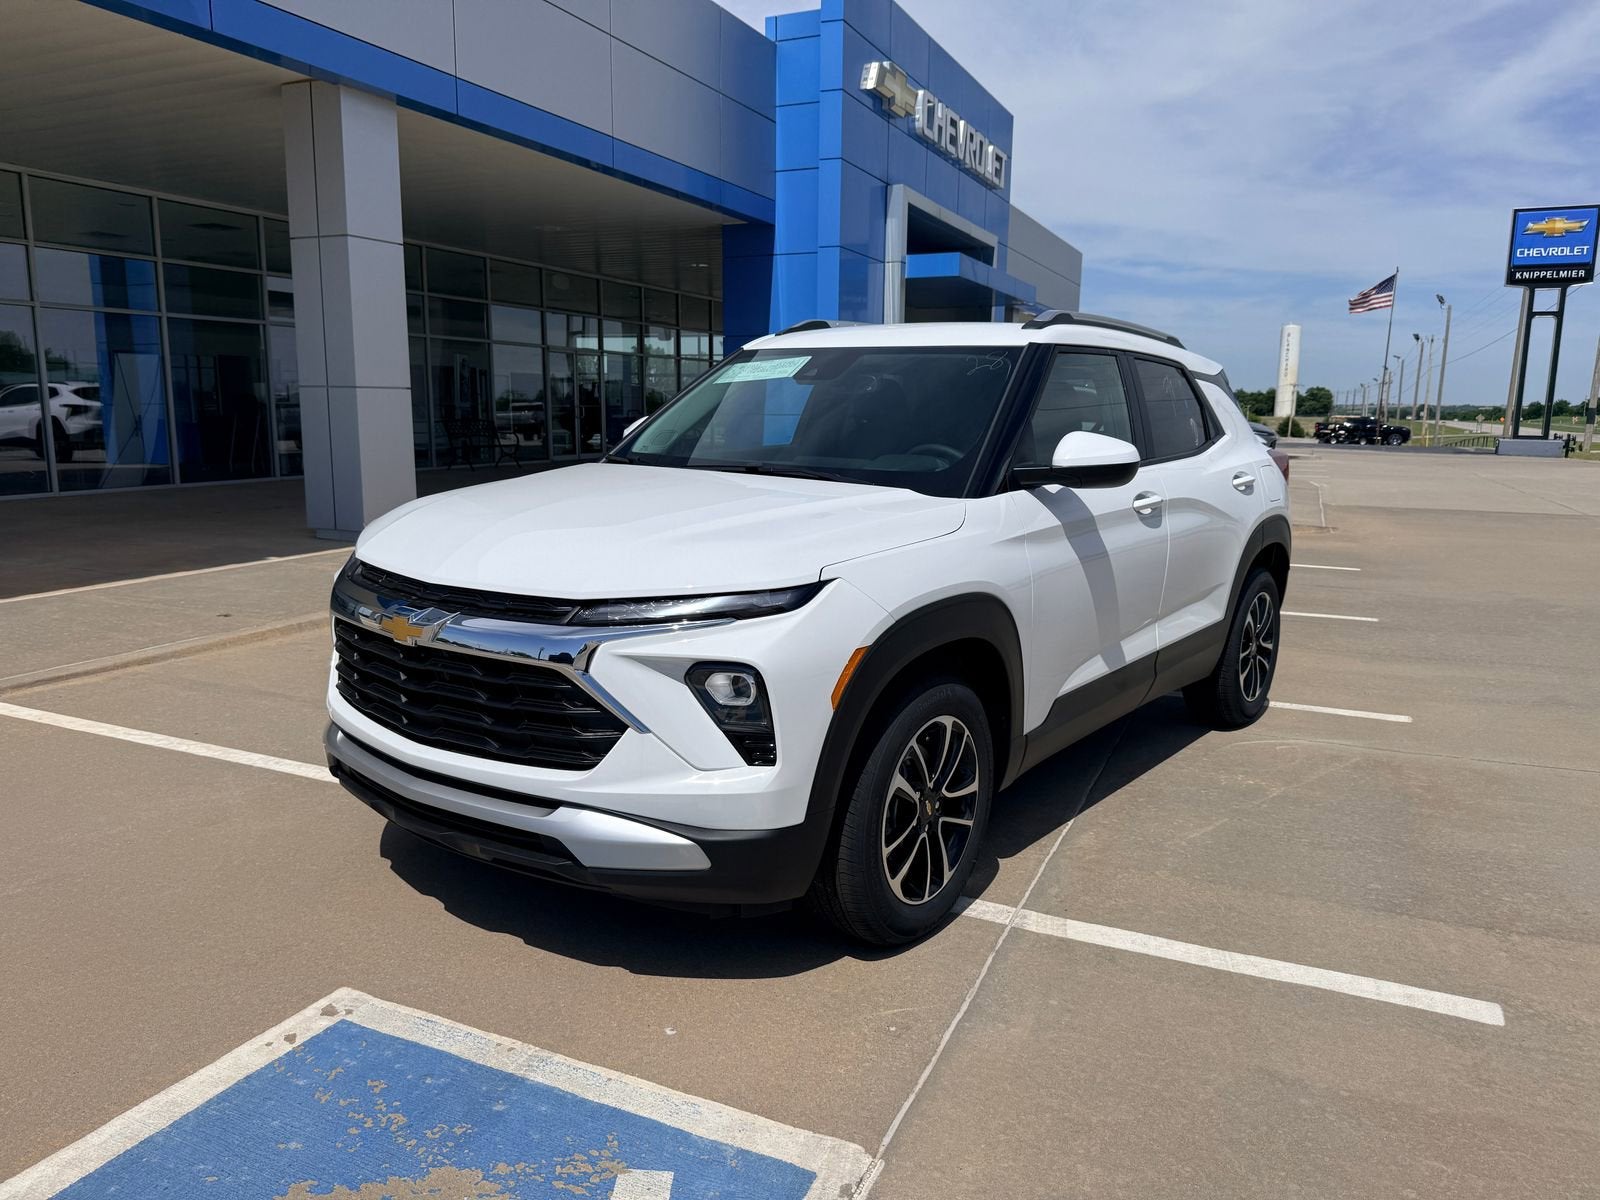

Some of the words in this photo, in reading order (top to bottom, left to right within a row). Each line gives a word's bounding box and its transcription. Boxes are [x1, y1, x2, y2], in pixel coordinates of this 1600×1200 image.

[915, 89, 1008, 189] CHEVROLET
[1516, 245, 1590, 258] CHEVROLET
[1515, 269, 1585, 280] KNIPPELMIER
